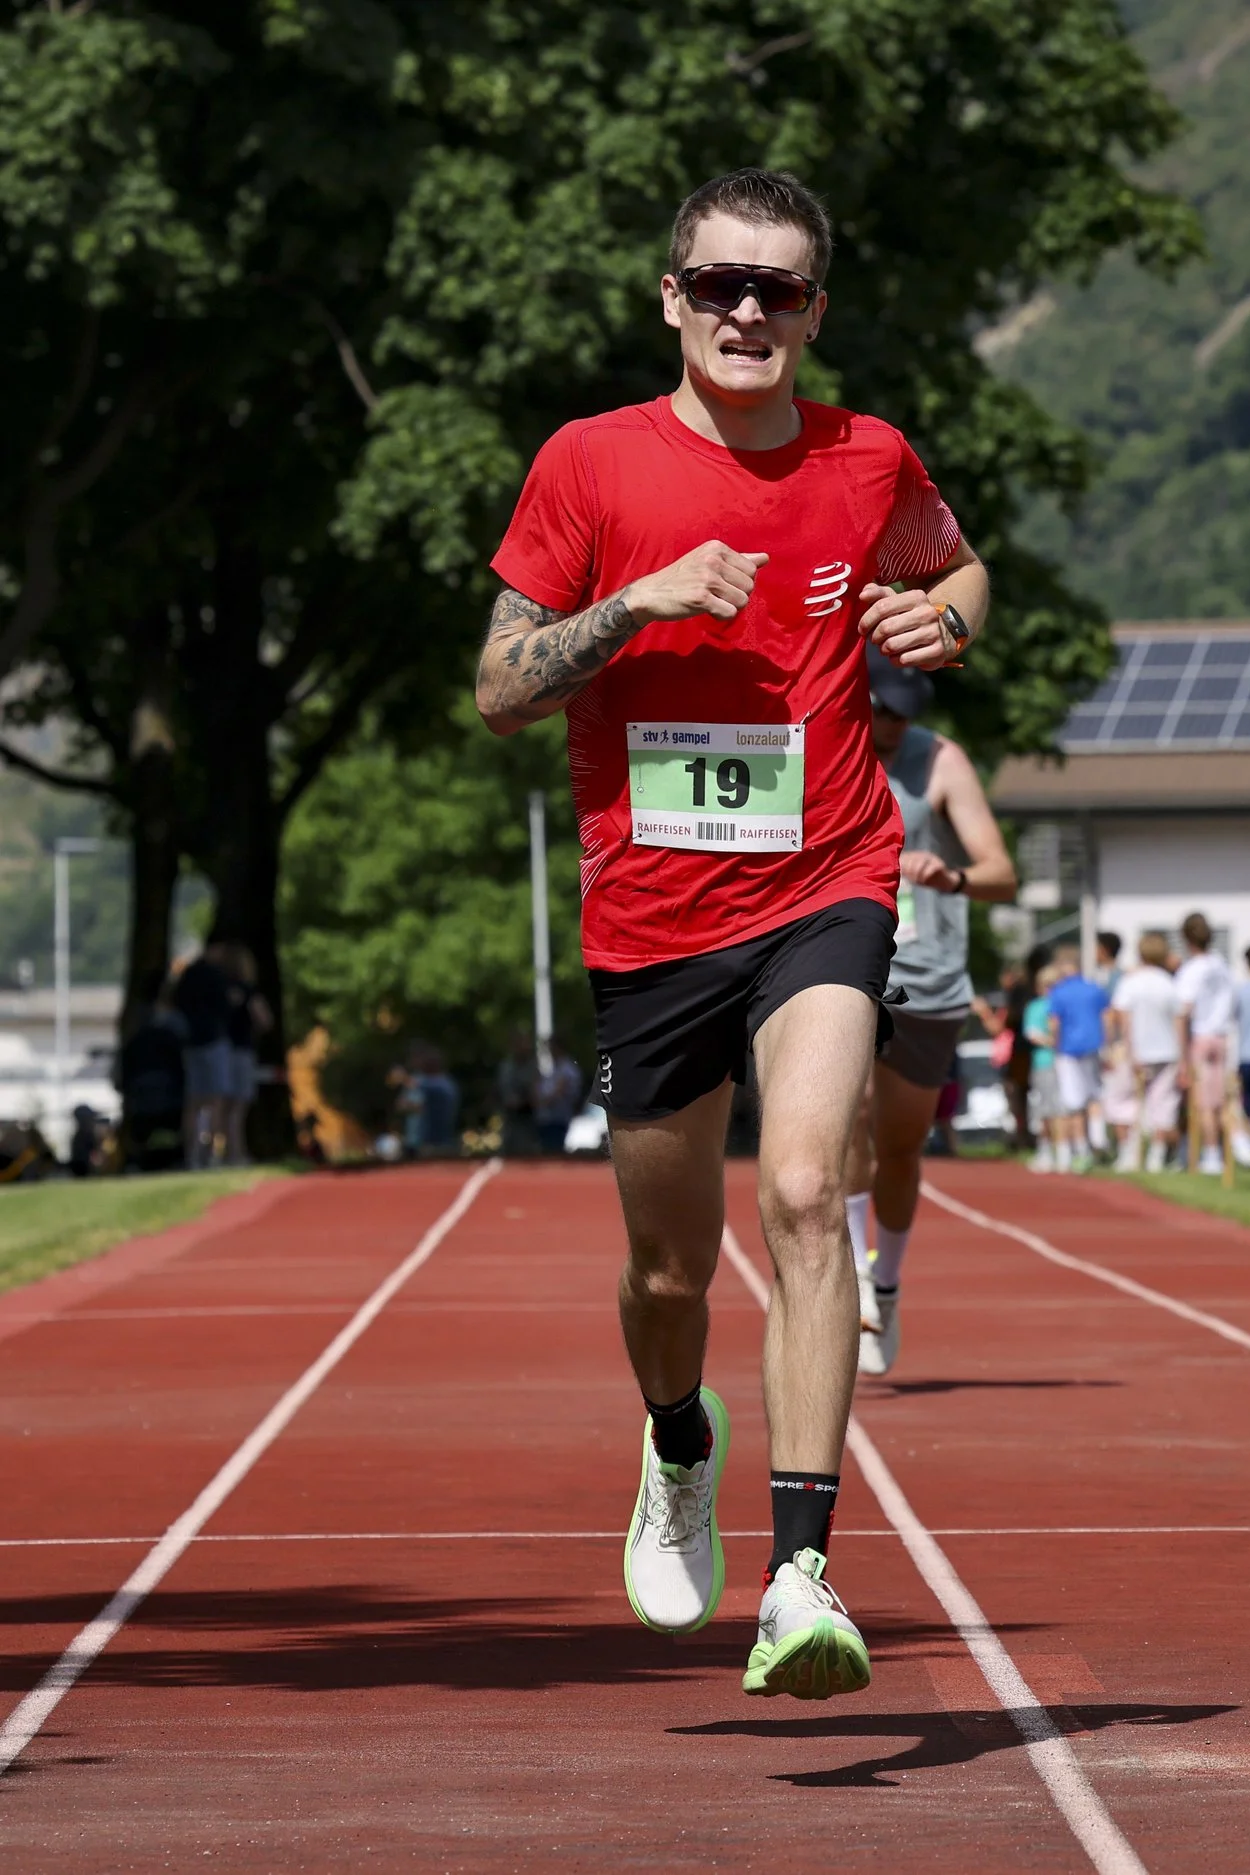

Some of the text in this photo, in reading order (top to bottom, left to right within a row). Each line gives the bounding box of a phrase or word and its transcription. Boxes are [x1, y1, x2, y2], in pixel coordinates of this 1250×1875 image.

[643, 731, 710, 745] stv gampel
[736, 731, 790, 746] lonzalauf
[685, 757, 750, 809] 19
[637, 822, 691, 835] RAIFFEISEN
[739, 828, 797, 839] RAIFFEISEN
